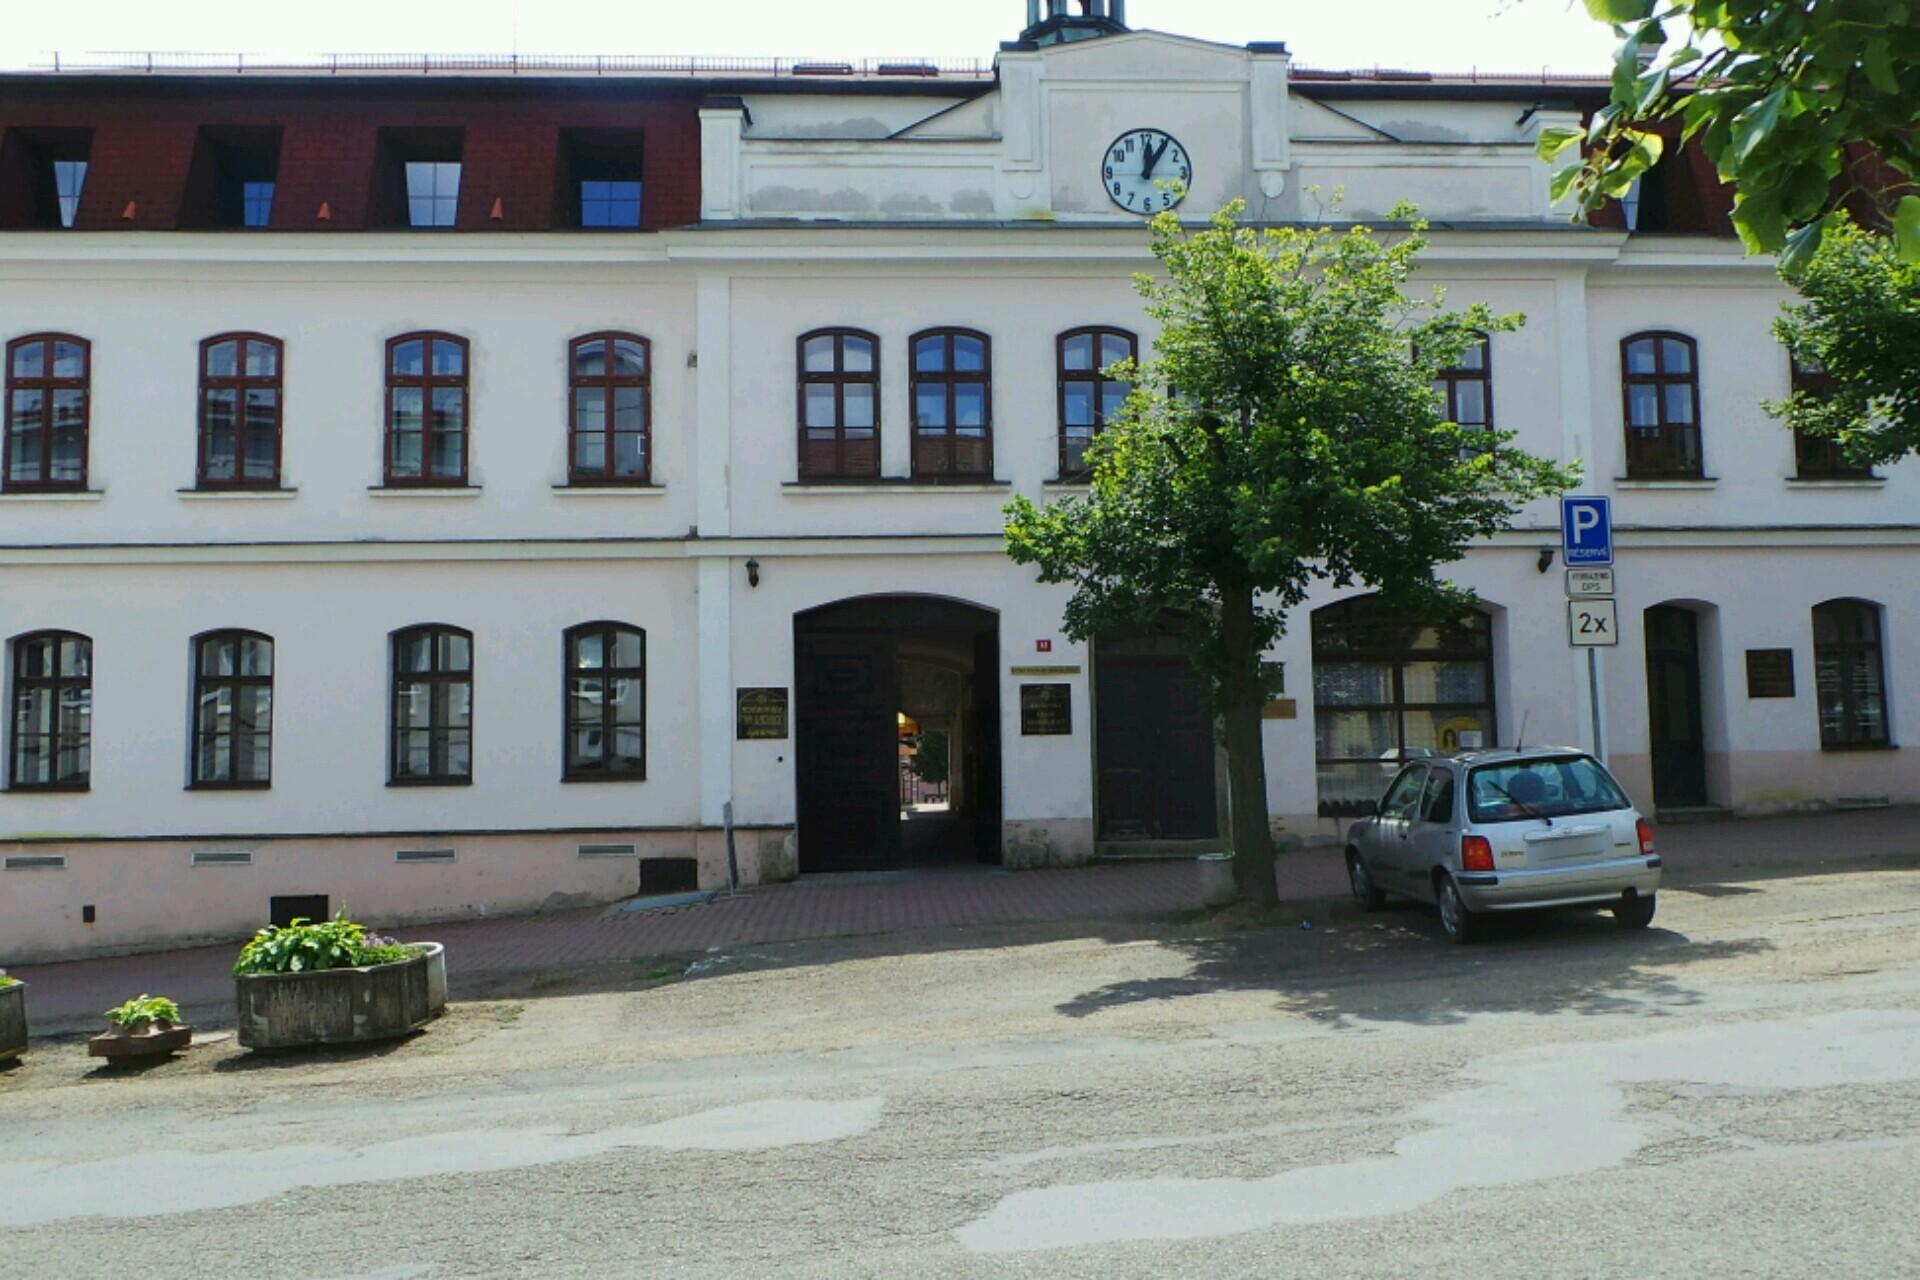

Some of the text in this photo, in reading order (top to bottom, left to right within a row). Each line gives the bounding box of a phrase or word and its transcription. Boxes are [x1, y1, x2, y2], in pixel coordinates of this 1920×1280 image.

[1124, 139, 1134, 152] 11
[1113, 149, 1124, 162] 10
[1171, 150, 1179, 162] 2
[1106, 166, 1113, 179] 9
[1179, 166, 1187, 179] 3
[1113, 182, 1121, 195] 8
[1127, 192, 1135, 206] 7
[1144, 197, 1152, 211] 6
[1163, 193, 1170, 206] 5
[1572, 505, 1599, 544] P
[1579, 611, 1607, 633] 2x
